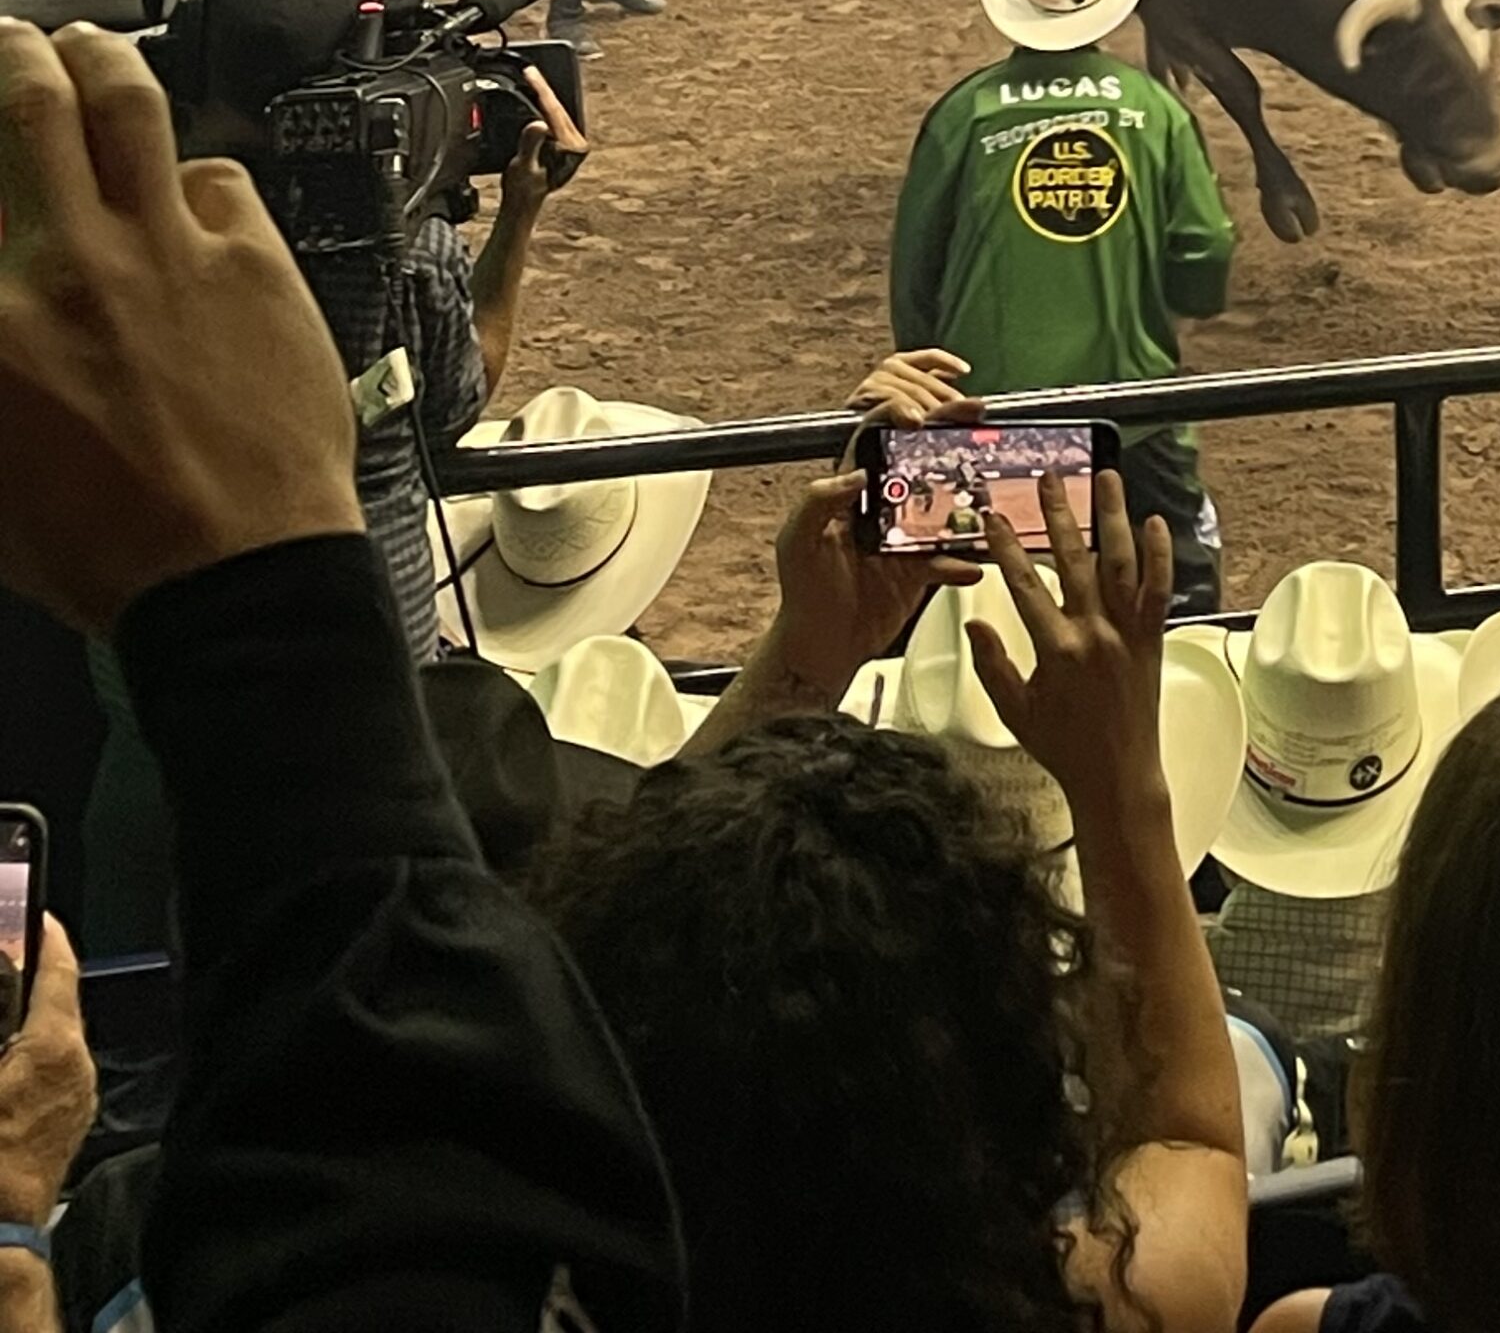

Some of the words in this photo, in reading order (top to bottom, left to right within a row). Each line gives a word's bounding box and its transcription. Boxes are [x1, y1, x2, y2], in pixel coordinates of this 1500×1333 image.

[1000, 76, 1122, 105] LUCAS
[1028, 166, 1116, 187] BORDER
[1029, 189, 1113, 209] PATROL
